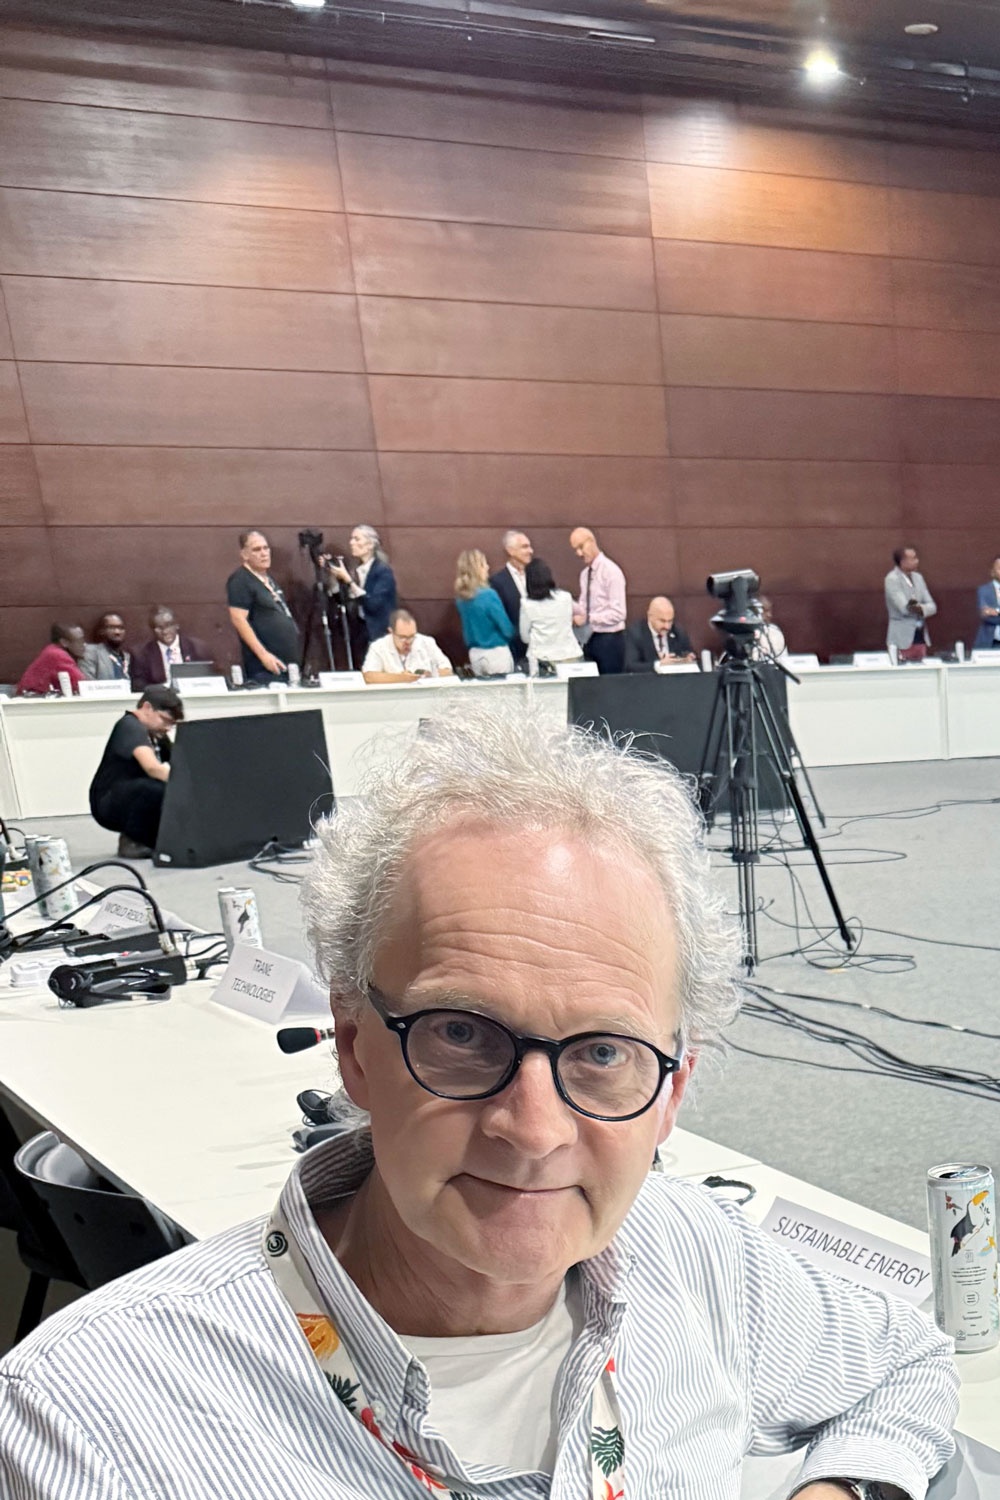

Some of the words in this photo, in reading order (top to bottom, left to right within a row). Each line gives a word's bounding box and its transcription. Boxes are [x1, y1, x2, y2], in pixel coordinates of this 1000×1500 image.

[253, 959, 273, 977] TRANE
[231, 977, 276, 1004] TECHNOLOGIES
[772, 1216, 869, 1265] SUSTAINABLE
[865, 1252, 931, 1288] ENERGY
